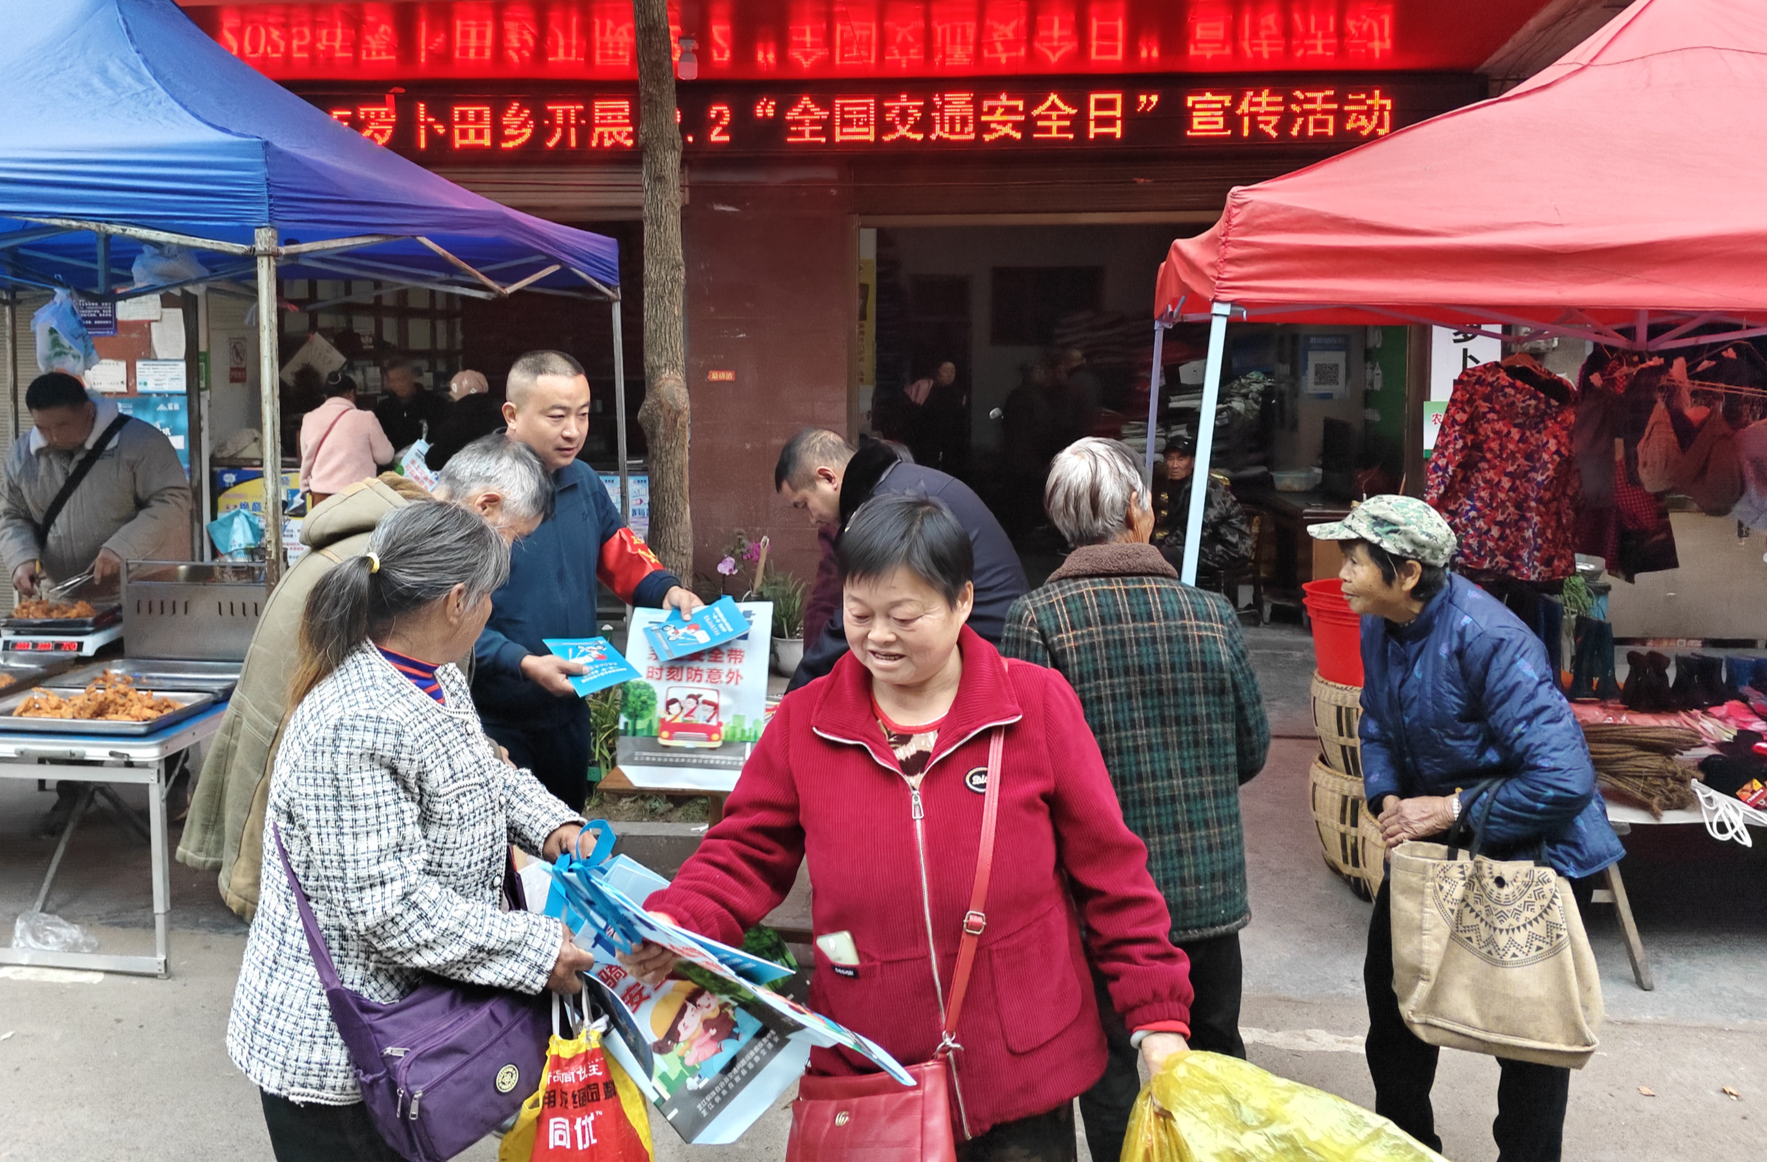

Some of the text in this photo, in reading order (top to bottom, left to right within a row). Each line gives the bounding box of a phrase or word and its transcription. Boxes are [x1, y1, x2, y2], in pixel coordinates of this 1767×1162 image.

[1186, 88, 1392, 138] 宣传活动
[646, 665, 743, 685] 时刻防意外
[548, 1113, 597, 1151] 同优
